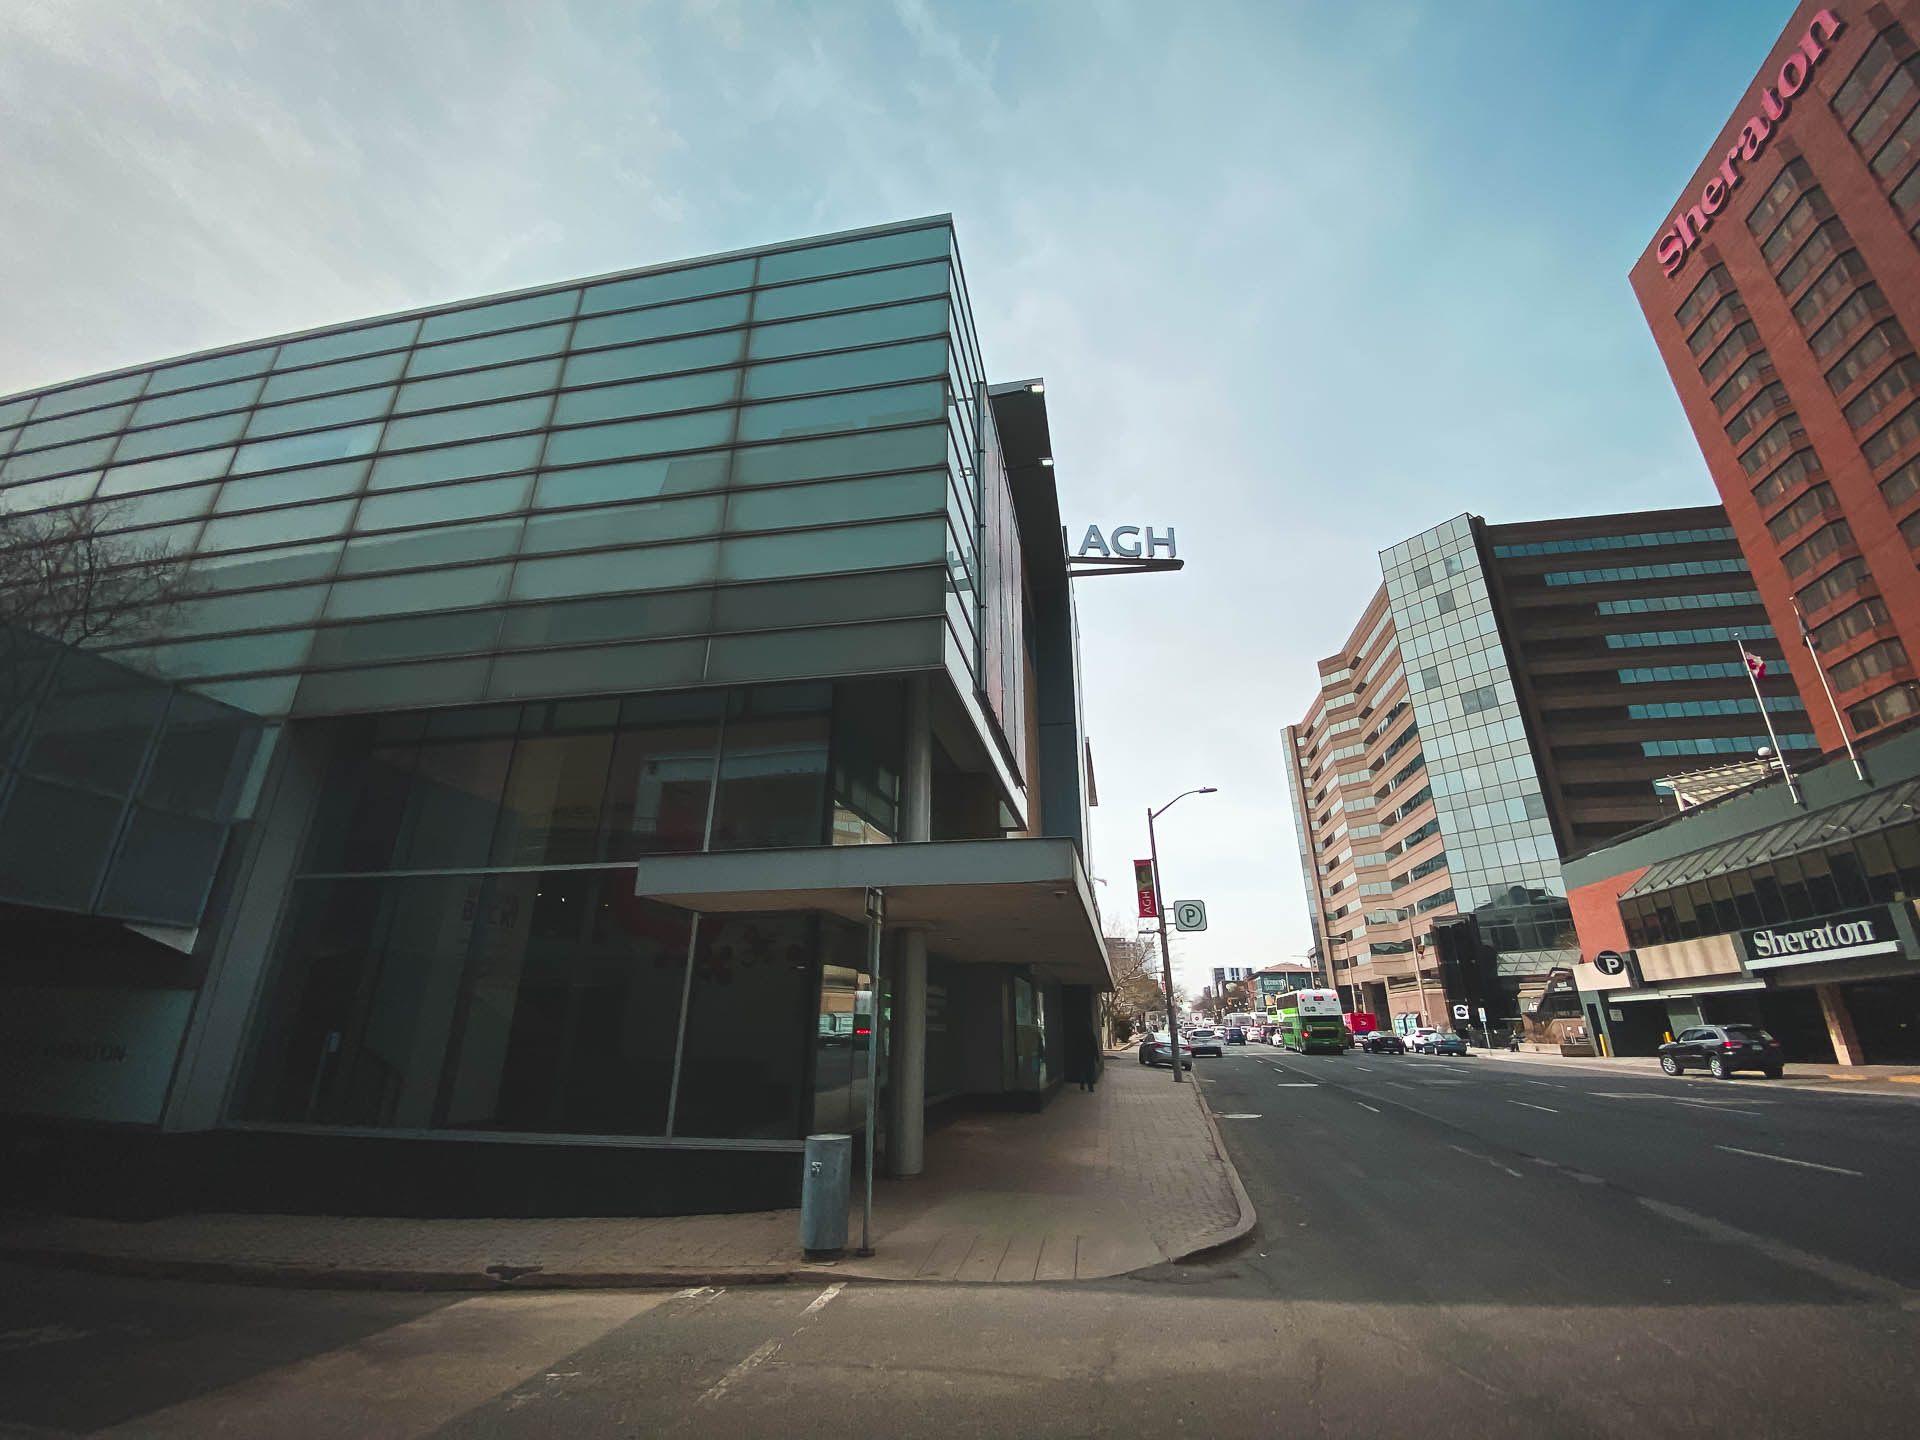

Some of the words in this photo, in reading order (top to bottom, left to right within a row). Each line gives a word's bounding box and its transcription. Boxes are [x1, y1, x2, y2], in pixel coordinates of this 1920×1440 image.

[1656, 9, 1840, 278] Sheraton
[1078, 524, 1177, 558] AGH
[1141, 891, 1152, 914] AGH
[1185, 908, 1195, 923] P
[1753, 920, 1874, 957] Sheraton
[1605, 958, 1619, 974] P
